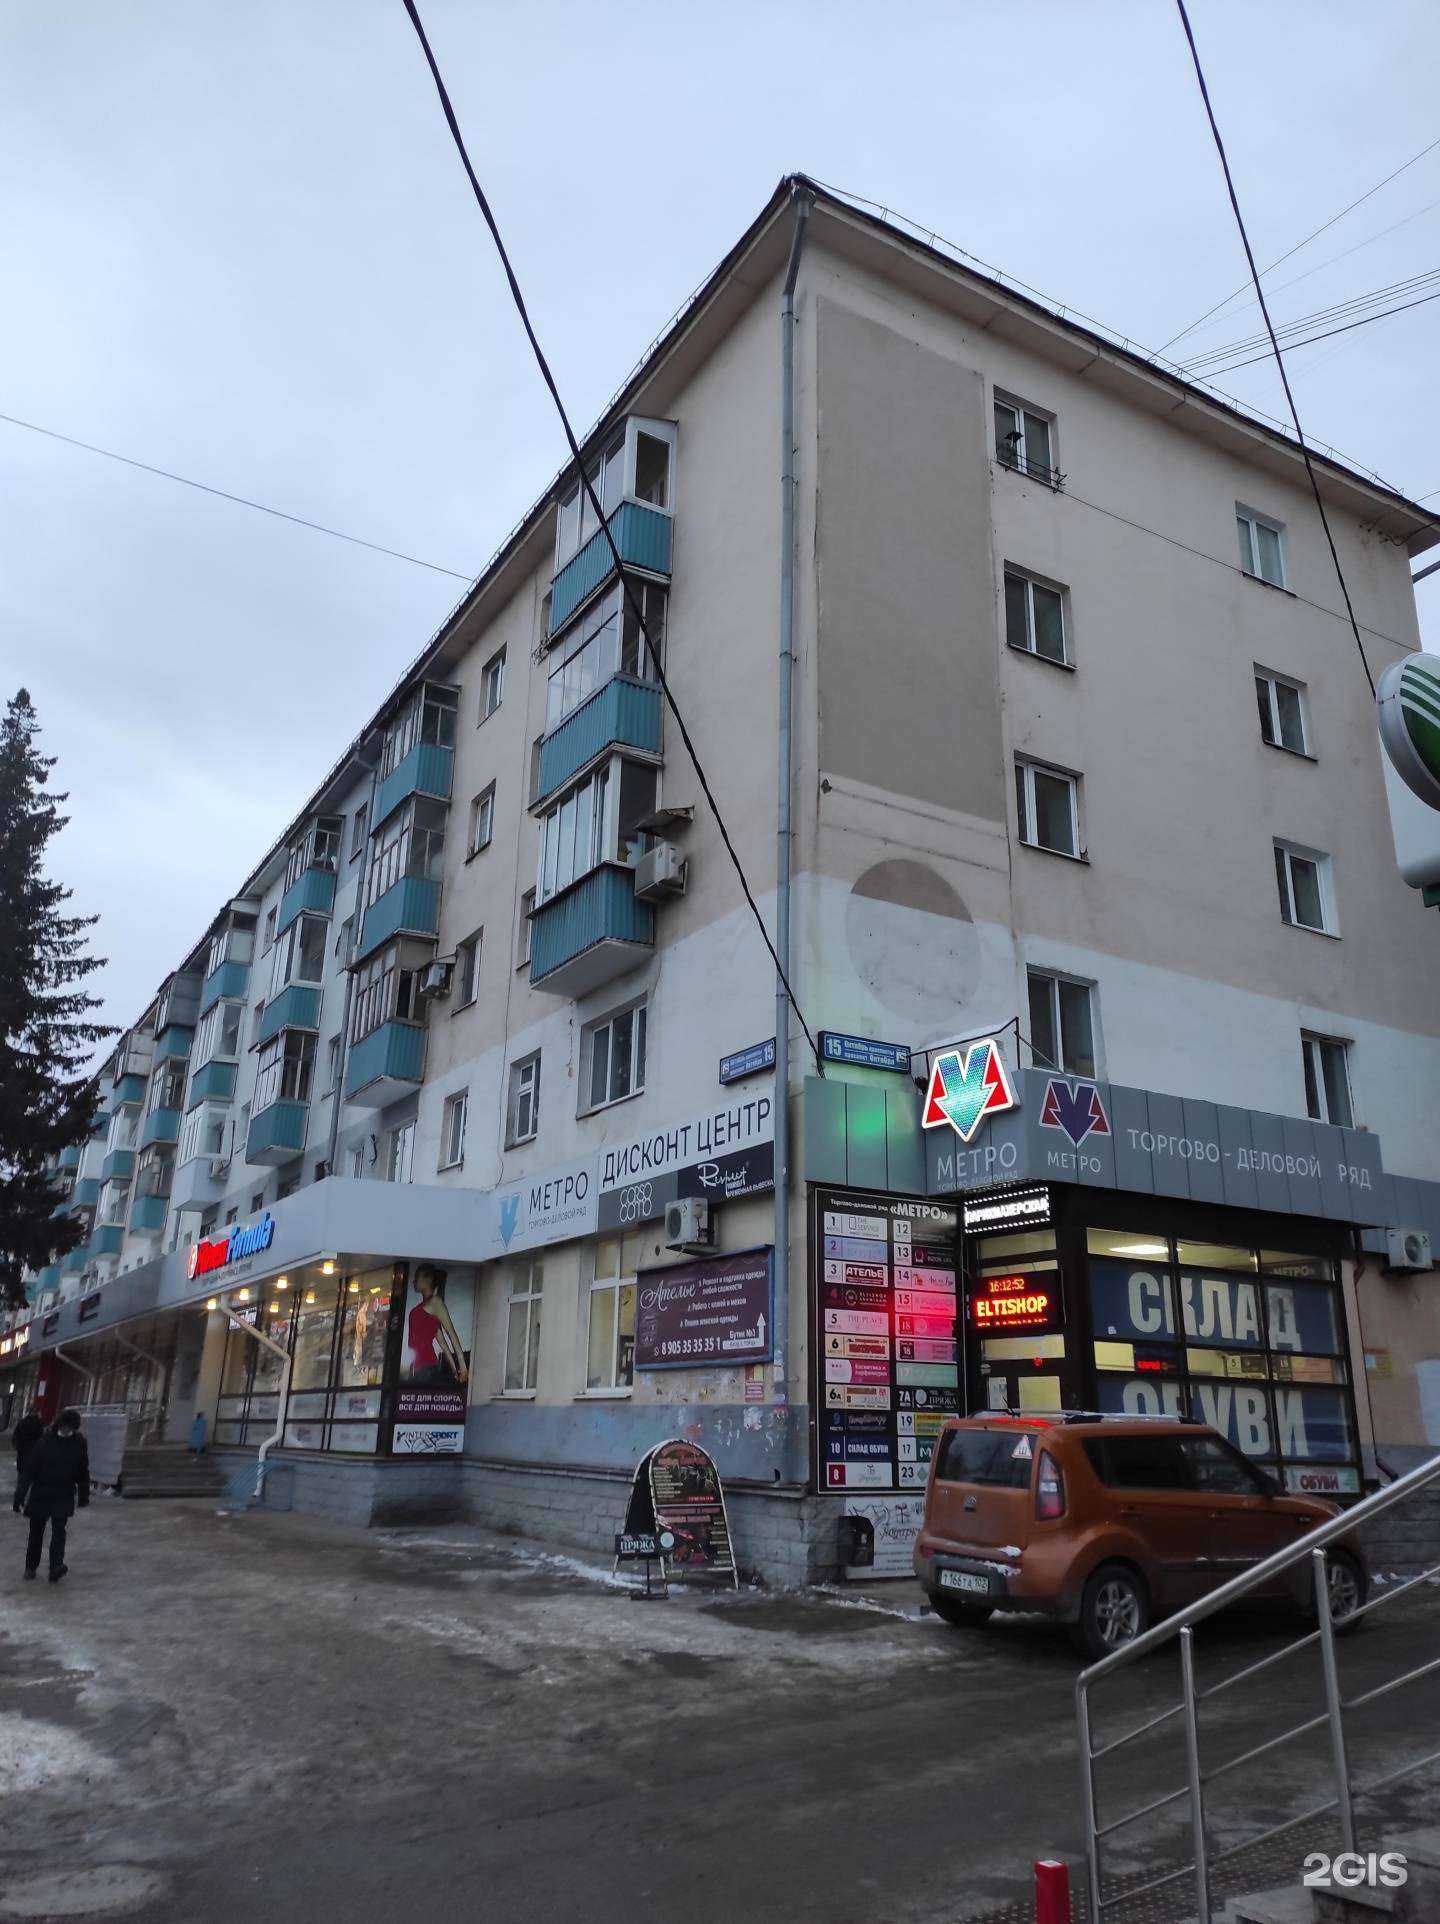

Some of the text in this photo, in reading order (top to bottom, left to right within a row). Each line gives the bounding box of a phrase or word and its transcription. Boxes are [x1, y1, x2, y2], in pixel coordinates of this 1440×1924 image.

[764, 1043, 773, 1061] 15
[827, 1038, 842, 1056] 15
[602, 1097, 771, 1188] ДИСКОНТ ЦЕНТР
[937, 1142, 1017, 1181] МЕТРО
[1047, 1151, 1101, 1174] МЕТРО
[1127, 1128, 1220, 1163] ТОРГОВО
[1237, 1148, 1322, 1179] ДЕЛОВОЙ
[1338, 1163, 1372, 1191] РЯД
[697, 1163, 747, 1197] Respect
[529, 1170, 589, 1215] МЕТРО
[831, 1216, 836, 1227] 1
[897, 1223, 908, 1234] 12
[831, 1241, 836, 1250] 2
[897, 1246, 909, 1258] 13
[831, 1264, 836, 1275] 3
[846, 1266, 884, 1278] АТЕЛЬЕ
[898, 1270, 910, 1281] 14
[990, 1278, 1025, 1294] 16:12:52
[640, 1280, 696, 1311] Ателье
[898, 1294, 910, 1305] 15
[976, 1295, 1048, 1318] ELTISHOP
[1127, 1271, 1303, 1353] СКЛАД
[831, 1313, 837, 1324] 5
[730, 1330, 745, 1341] Бутик
[661, 1342, 667, 1356] 8
[667, 1340, 681, 1355] 905
[682, 1340, 692, 1354] 35
[693, 1338, 703, 1352] 35
[704, 1338, 714, 1352] 35
[832, 1338, 838, 1349] 6
[401, 1394, 463, 1403] ВСЕ ДЛЯ СПОРТА,
[414, 1404, 430, 1412] ДЛЯ
[901, 1416, 913, 1427] 19
[405, 1431, 458, 1440] INTERSPORT
[830, 1442, 840, 1454] 10
[847, 1444, 889, 1455] СКЛАД ОБУВИ
[902, 1444, 911, 1455] 17
[901, 1467, 914, 1478] 23
[1300, 1474, 1340, 1490] ОБУВИ
